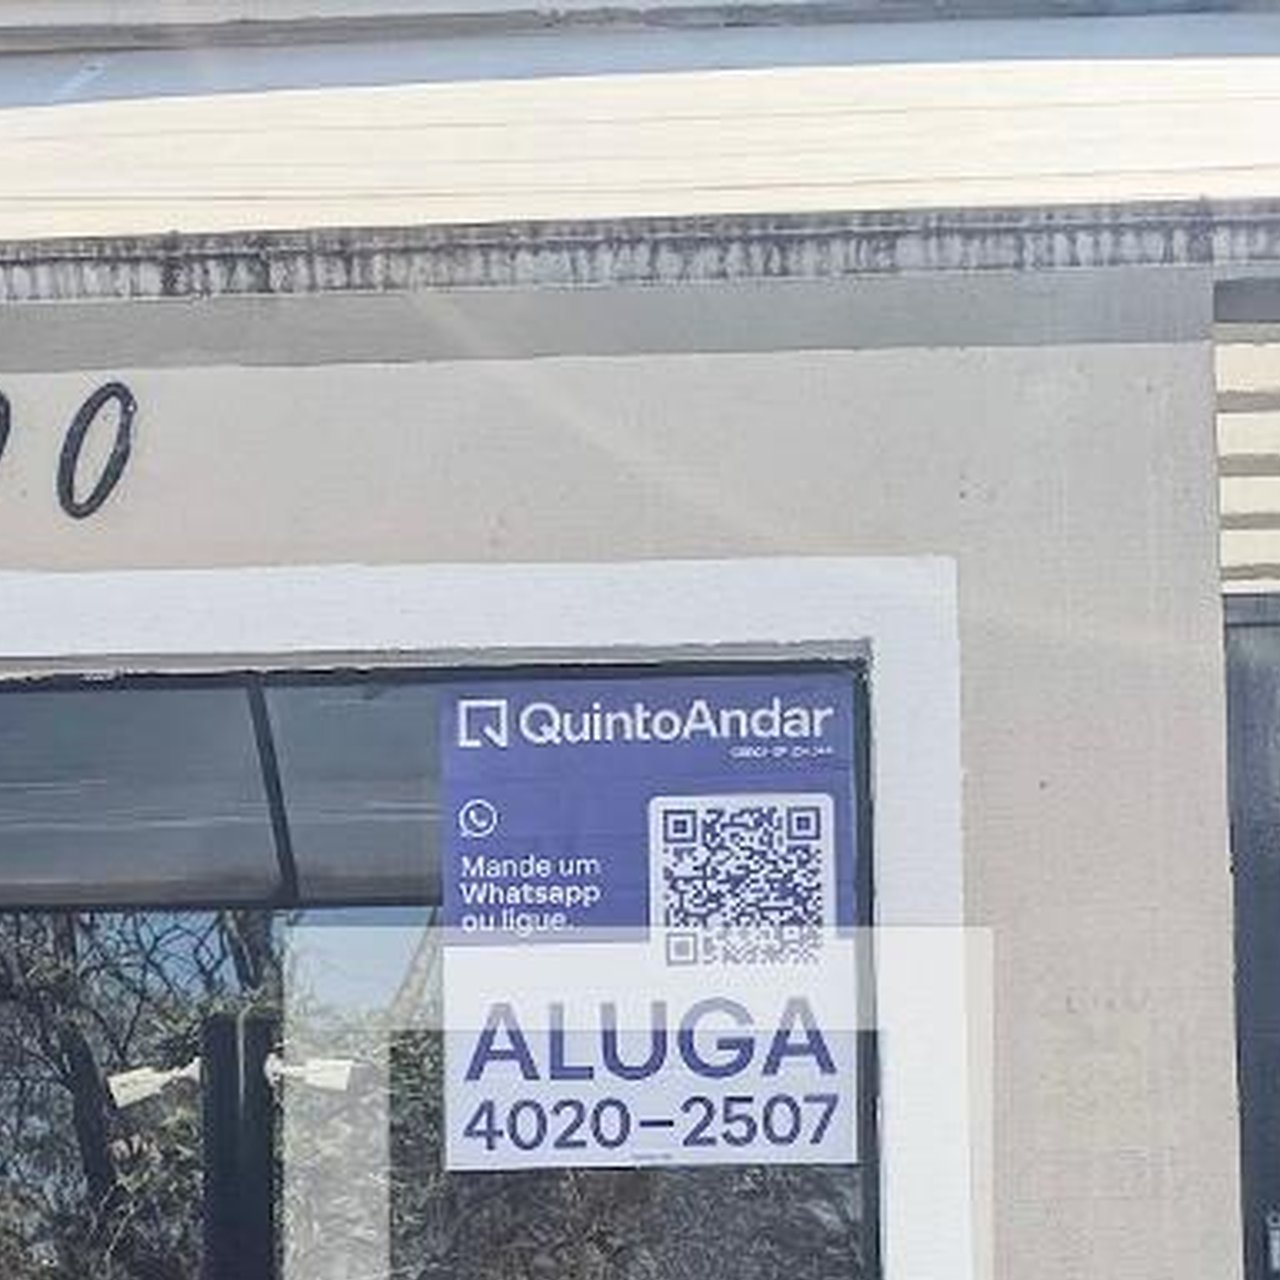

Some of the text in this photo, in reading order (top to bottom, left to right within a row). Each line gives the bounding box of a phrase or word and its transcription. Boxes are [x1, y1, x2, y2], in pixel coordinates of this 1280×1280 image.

[520, 698, 834, 744] QuintoAndar
[461, 854, 601, 878] Mande um
[459, 882, 601, 908] Whatsapp
[461, 913, 495, 932] ou
[464, 997, 838, 1081] ALUGA
[463, 1094, 839, 1151] 4020-2507
